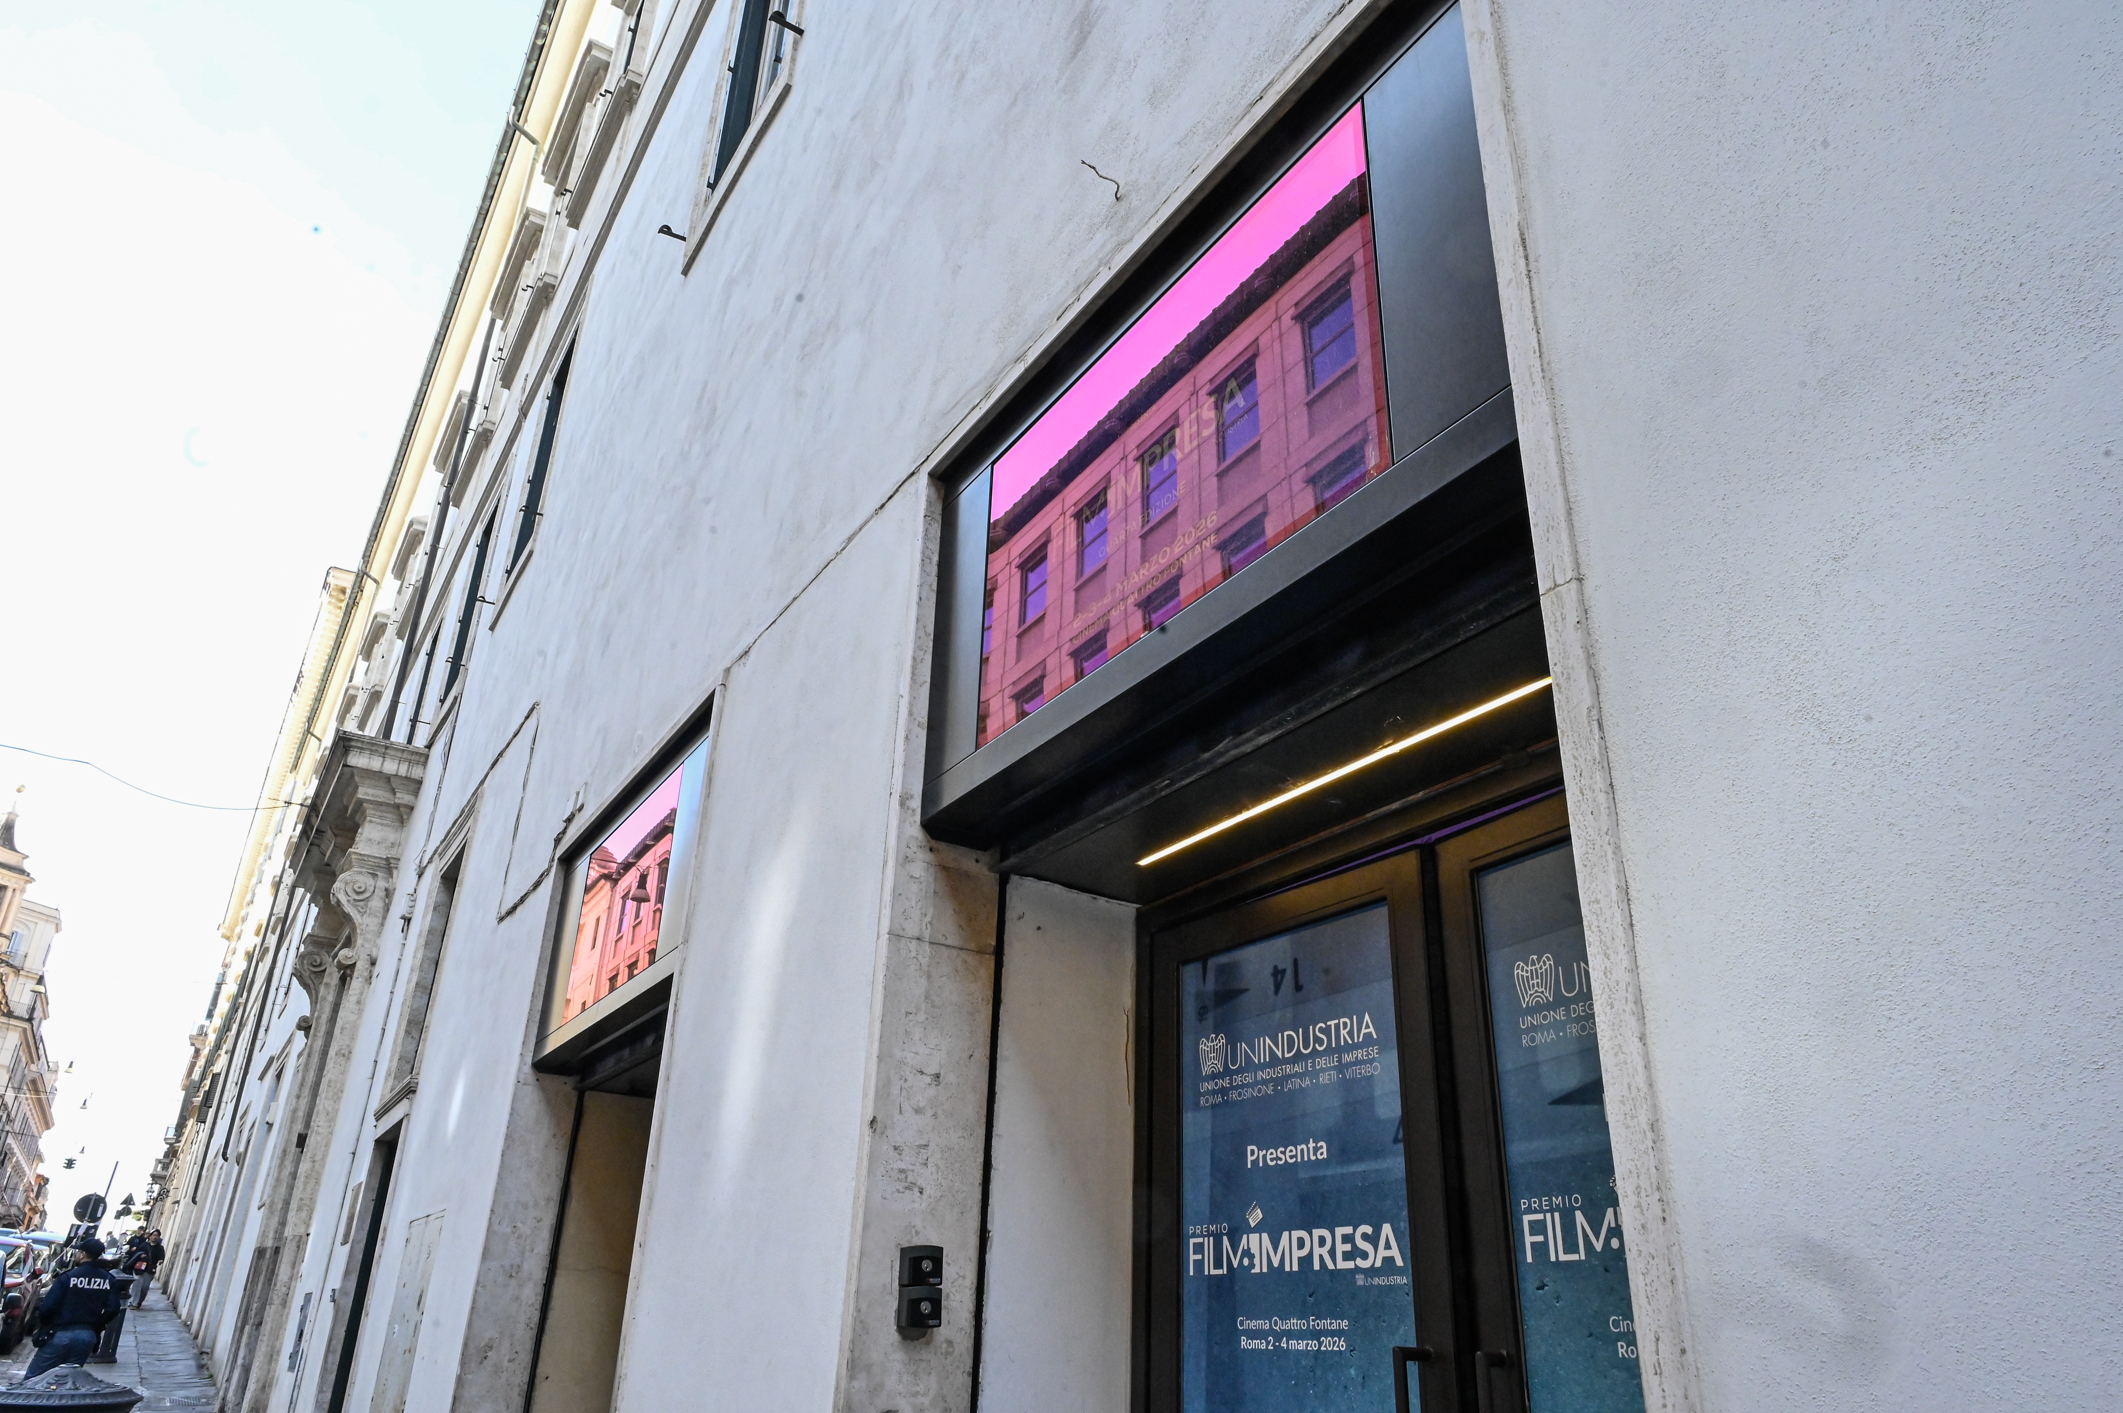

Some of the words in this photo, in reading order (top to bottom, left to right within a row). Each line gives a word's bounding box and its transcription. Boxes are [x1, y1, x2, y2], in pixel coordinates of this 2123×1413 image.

[1139, 480, 1187, 527] EDIZIONE
[1114, 545, 1171, 596] MARZO
[1173, 511, 1218, 553] 2026
[1160, 531, 1218, 577] FONTANE
[1519, 1006, 1567, 1029] UNIONE
[1227, 1011, 1378, 1070] UNINDUSTRIA
[1521, 1029, 1557, 1048] ROMA
[1199, 1075, 1231, 1093] UNIONE
[1232, 1070, 1255, 1086] DEGLI
[1256, 1061, 1306, 1080] INDUSTRIALI
[1307, 1059, 1313, 1071] E
[1315, 1053, 1339, 1070] DELLE
[1341, 1045, 1380, 1065] IMPRESE
[1199, 1093, 1223, 1108] ROMA
[1228, 1082, 1275, 1102] FROSINONE
[1283, 1076, 1311, 1093] LATINA
[1318, 1070, 1338, 1085] RIETI
[1343, 1062, 1381, 1080] VITERBO
[1246, 1138, 1328, 1169] Presenta
[1520, 1194, 1582, 1212] PREMIO
[1188, 1223, 1229, 1236] PREMIO
[69, 1277, 111, 1290] POLIZIA
[1364, 1275, 1408, 1286] UNINDUSTRIA
[1237, 1316, 1270, 1330] Cinema
[1271, 1316, 1308, 1332] Quattro
[1309, 1316, 1349, 1330] Fontane
[1609, 1316, 1635, 1333] Cin
[1240, 1336, 1266, 1350] Roma
[1267, 1336, 1274, 1350] 2
[1280, 1336, 1287, 1350] 4
[1288, 1339, 1319, 1351] marzo
[1320, 1336, 1346, 1351] 2026
